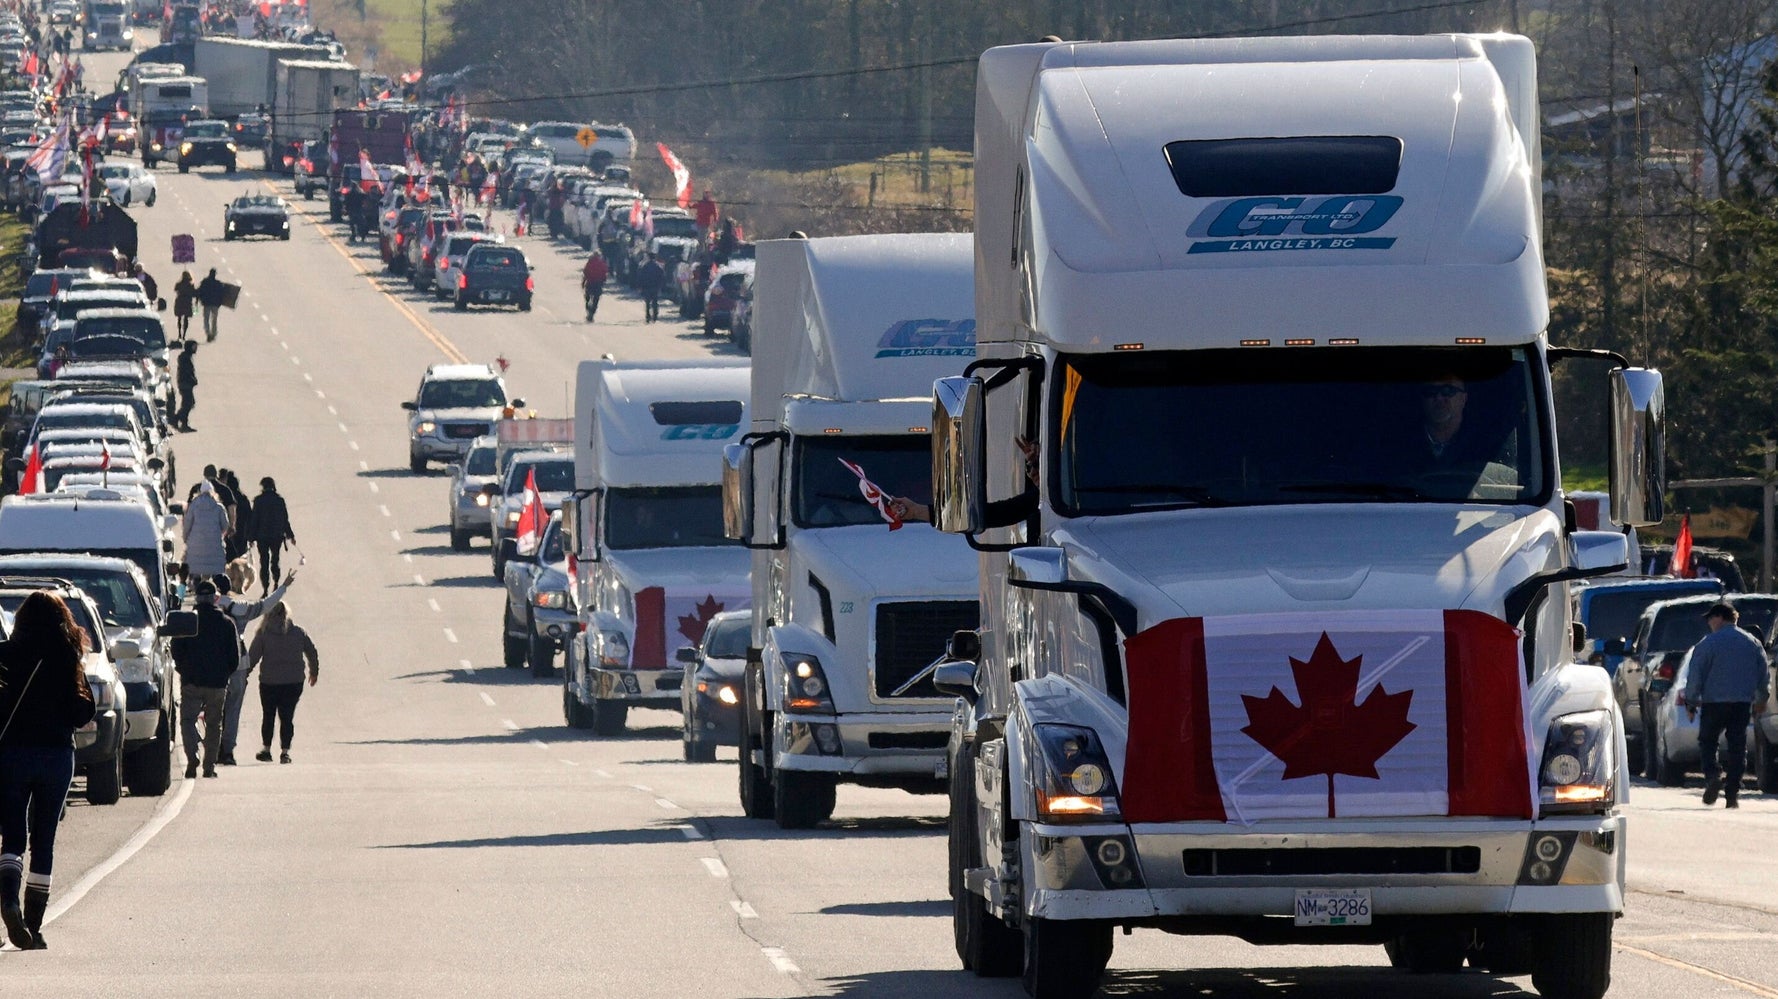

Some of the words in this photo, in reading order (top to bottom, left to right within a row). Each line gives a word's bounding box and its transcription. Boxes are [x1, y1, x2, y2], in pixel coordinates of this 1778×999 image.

[1206, 196, 1404, 237] GO
[1252, 213, 1328, 221] TRANSPORT
[1228, 239, 1322, 250] LANGLEY,
[1329, 239, 1356, 248] BC
[839, 601, 854, 614] 223
[1297, 898, 1317, 917] NM
[1328, 898, 1369, 917] 3286
